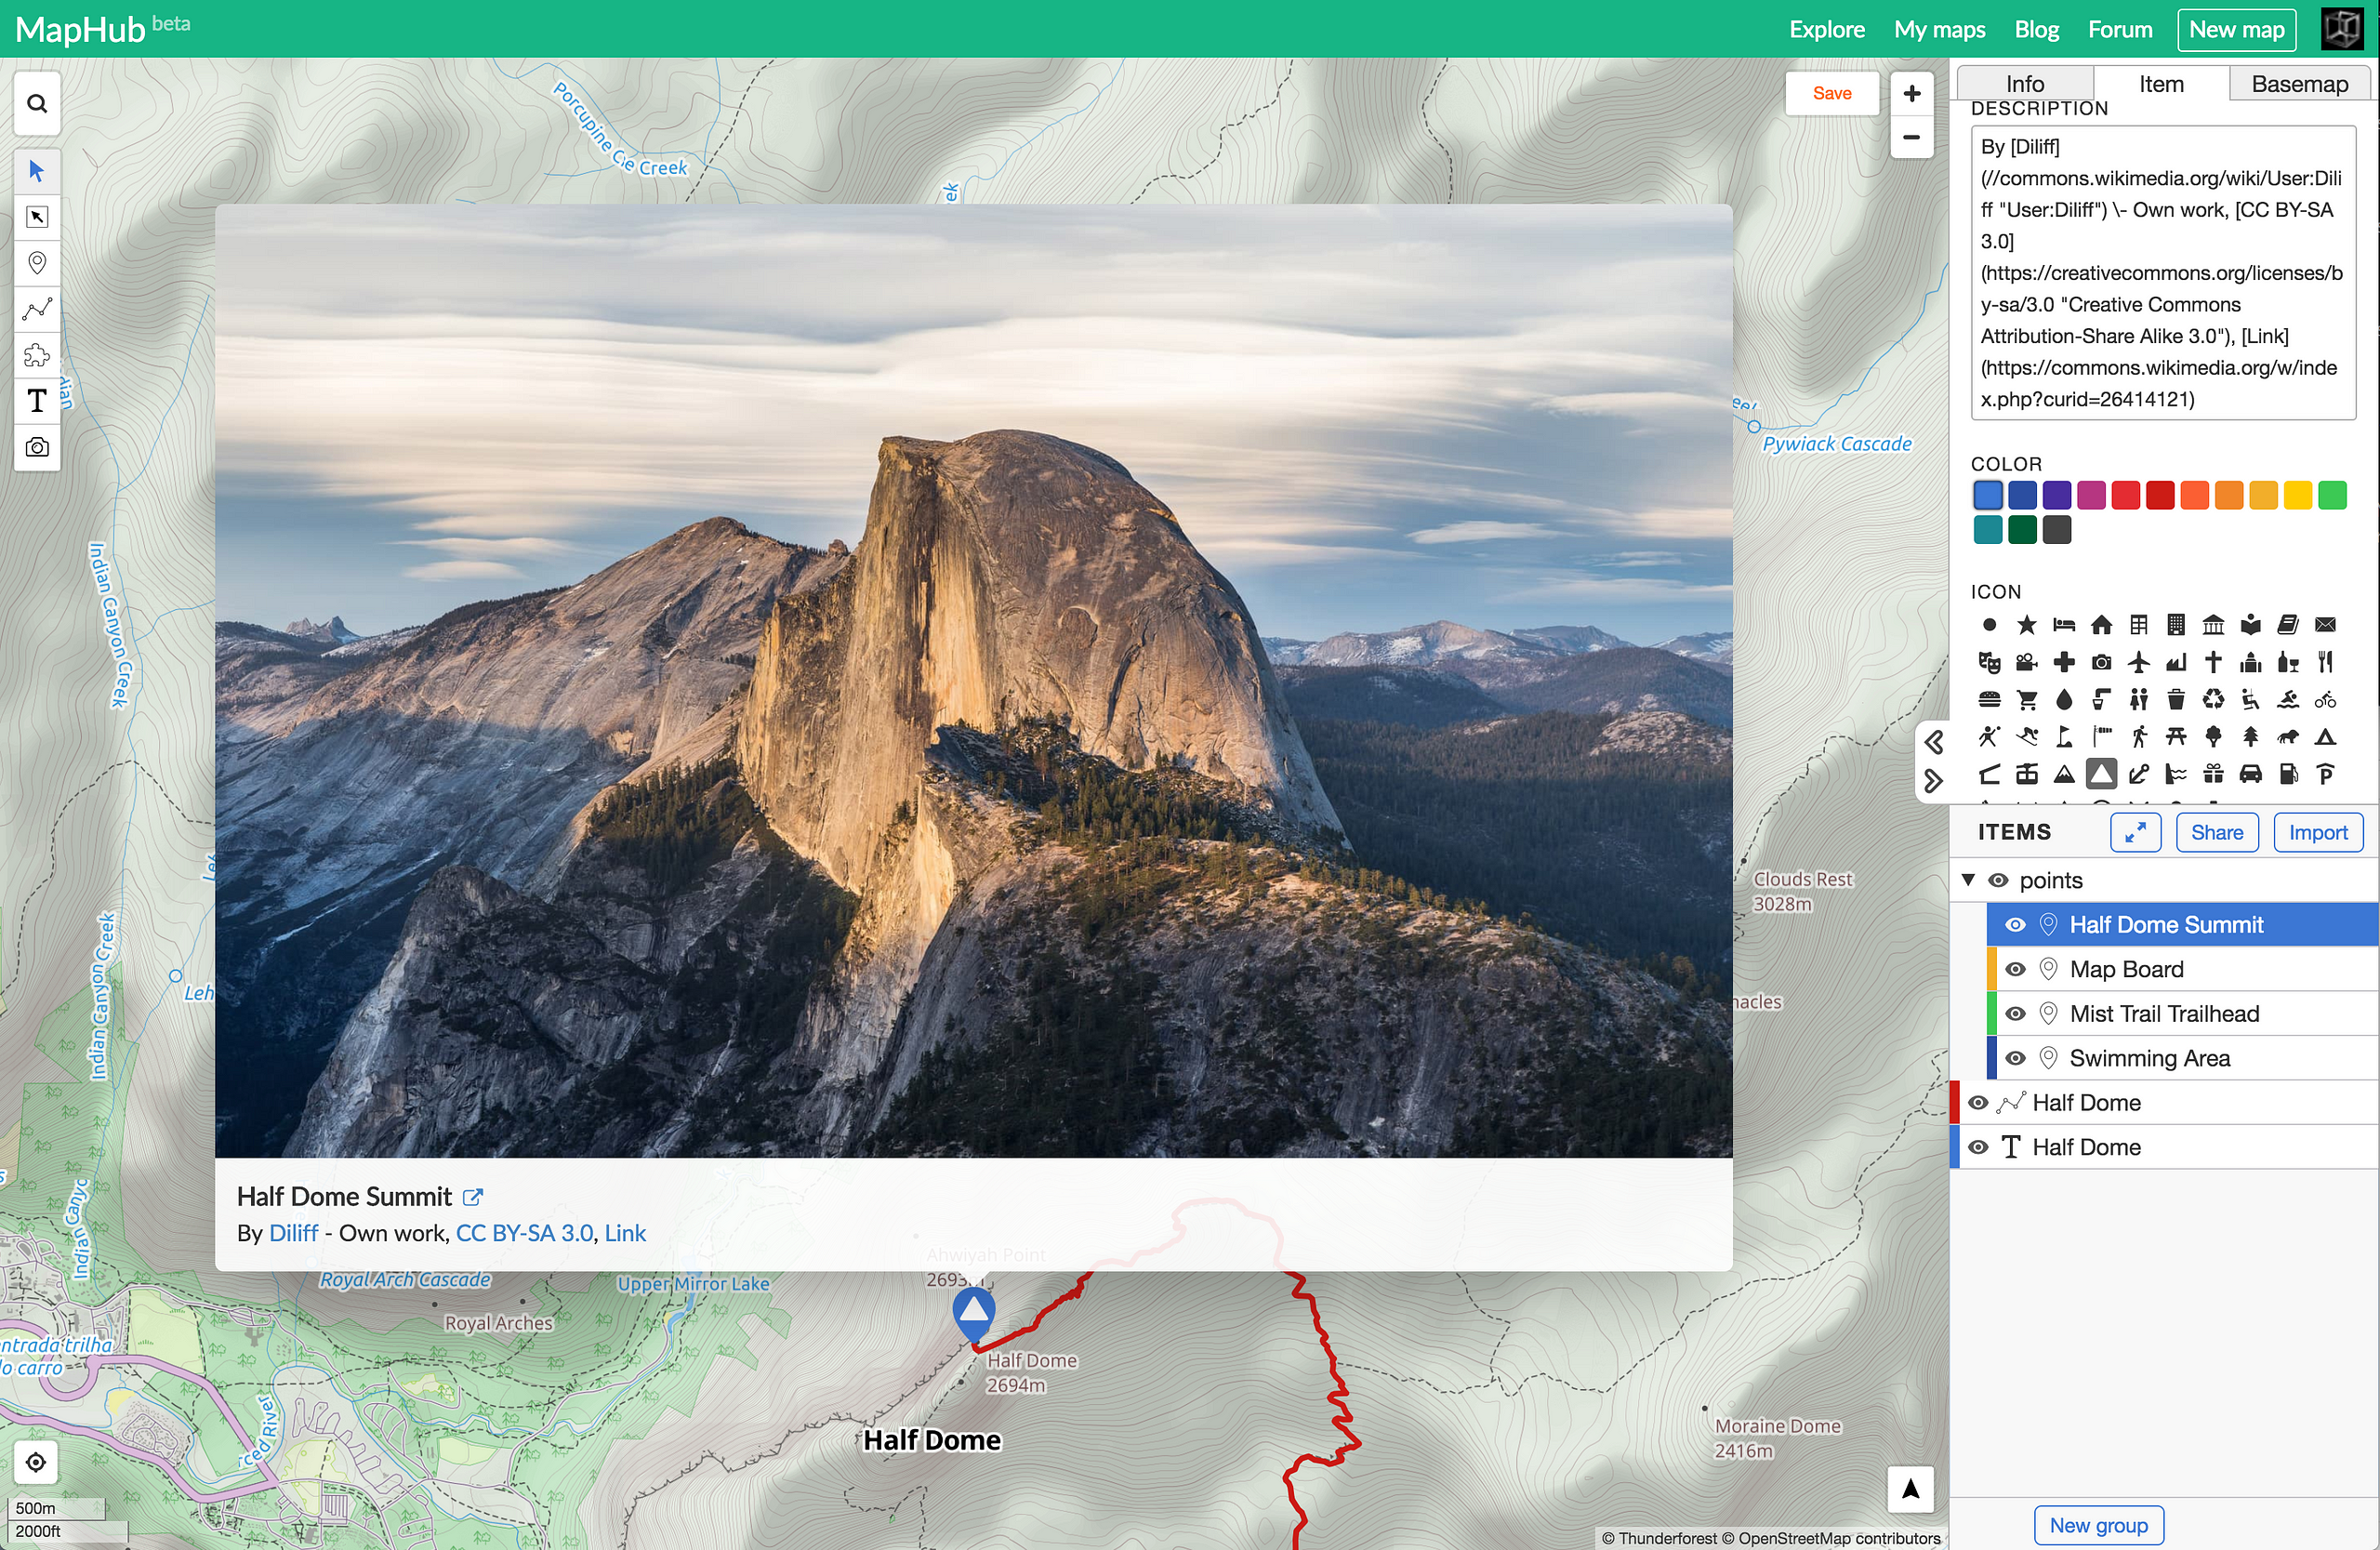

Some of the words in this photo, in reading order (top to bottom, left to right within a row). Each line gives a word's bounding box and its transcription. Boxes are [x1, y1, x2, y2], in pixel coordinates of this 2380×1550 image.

[17, 16, 145, 48] MapHub
[152, 15, 191, 31] beta
[1791, 20, 1865, 42] Explore
[1896, 20, 1927, 42] My
[1934, 25, 1986, 42] maps
[2016, 20, 2060, 42] Blog
[2090, 20, 2152, 38] Forum
[2190, 20, 2237, 38] New
[2243, 25, 2285, 42] map
[1814, 86, 1852, 99] Save
[2008, 75, 2044, 92] Info
[2141, 75, 2184, 92] Item
[2254, 75, 2348, 97] Basemap
[1972, 101, 2108, 115] DESCRIPTION
[553, 82, 613, 152] Porcupine
[641, 160, 687, 175] Creek
[1982, 139, 2005, 158] By
[2012, 139, 2059, 158] [Diliff]
[1982, 170, 2341, 190] (//commons.wikimedia.org/wiki/User:Dili
[1981, 202, 1993, 217] ff
[2001, 202, 2107, 221] "User:Diliff")
[2112, 202, 2127, 218] \-
[2134, 202, 2174, 218] Own
[2180, 202, 2228, 219] work,
[2237, 202, 2269, 221] [CC
[2277, 202, 2334, 218] BY-SA
[1981, 233, 2014, 253] 3.0]
[1982, 265, 2343, 285] (https://creativecommons.org/licenses/b
[1981, 297, 2054, 316] y-sa/3.0
[2062, 297, 2142, 311] "Creative
[2149, 297, 2241, 311] Commons
[1981, 328, 2135, 343] Attribution-Share
[2140, 328, 2183, 343] Alike
[2189, 328, 2235, 347] 3.0"),
[2242, 328, 2288, 347] [Link]
[1982, 360, 2337, 379] (https://commons.wikimedia.org/w/inde
[1981, 391, 2194, 410] x.php?curid=26414121)
[1764, 436, 1835, 454] Pywiack
[1842, 435, 1911, 451] Cascade
[1972, 457, 2042, 471] COLOR
[90, 543, 112, 593] Indian
[1973, 585, 2020, 599] ICON
[104, 598, 125, 657] Canyon
[112, 662, 132, 707] Creek
[1979, 824, 2051, 840] ITEMS
[2192, 825, 2243, 840] Share
[2291, 825, 2348, 843] Import
[1755, 872, 1810, 886] Clouds
[1818, 873, 1852, 886] Rest
[2021, 871, 2082, 893] points
[1755, 897, 1810, 910] 3028m
[2071, 916, 2111, 934] Half
[2119, 916, 2178, 934] Dome
[2186, 916, 2264, 934] Summit
[97, 914, 113, 960] Creek
[2071, 960, 2115, 982] Map
[2124, 960, 2183, 977] Board
[93, 965, 111, 1024] Canyon
[2071, 1005, 2113, 1022] Mist
[2121, 1005, 2160, 1022] Trail
[2168, 1005, 2259, 1022] Trailhead
[89, 1030, 105, 1079] Indian
[2070, 1049, 2176, 1071] Swimming
[2184, 1050, 2231, 1066] Area
[2034, 1093, 2074, 1111] Half
[2082, 1093, 2141, 1111] Dome
[2034, 1138, 2074, 1156] Half
[2082, 1138, 2141, 1156] Dome
[239, 1186, 284, 1206] Half
[293, 1186, 359, 1206] Dome
[367, 1186, 452, 1206] Summit
[239, 1225, 263, 1245] By
[271, 1224, 319, 1241] Diliff
[339, 1225, 387, 1241] Own
[394, 1224, 449, 1244] work,
[456, 1224, 486, 1241] CC
[494, 1224, 556, 1241] BY-SA
[562, 1224, 598, 1244] 3.0,
[606, 1224, 646, 1241] Link
[74, 1228, 89, 1278] Indian
[322, 1272, 369, 1290] Royal
[374, 1272, 413, 1286] Arch
[420, 1272, 490, 1286] Cascade
[620, 1278, 669, 1293] Upper
[676, 1277, 726, 1292] Mirror
[734, 1277, 769, 1291] Lake
[447, 1316, 489, 1333] Royal
[496, 1316, 551, 1330] Arches
[0, 1337, 60, 1352] ntrada
[66, 1337, 112, 1352] trilha
[19, 1364, 62, 1374] carro
[988, 1353, 1022, 1368] Half
[1027, 1354, 1078, 1368] Dome
[988, 1379, 1044, 1392] 2694m
[258, 1395, 279, 1437] River
[1717, 1419, 1784, 1433] Moraine
[1792, 1420, 1840, 1433] Dome
[864, 1429, 919, 1451] Half
[925, 1430, 1001, 1451] Dome
[1716, 1444, 1772, 1457] 2416m
[17, 1503, 55, 1514] 500m
[17, 1525, 60, 1537] 2000ft
[2051, 1517, 2091, 1533] New
[2096, 1521, 2149, 1537] group
[1603, 1532, 1614, 1544] ©
[1620, 1532, 1717, 1544] Thunderforest
[1723, 1532, 1734, 1544] ©
[1739, 1532, 1850, 1547] OpenStreetMap
[1857, 1532, 1940, 1544] contributors
